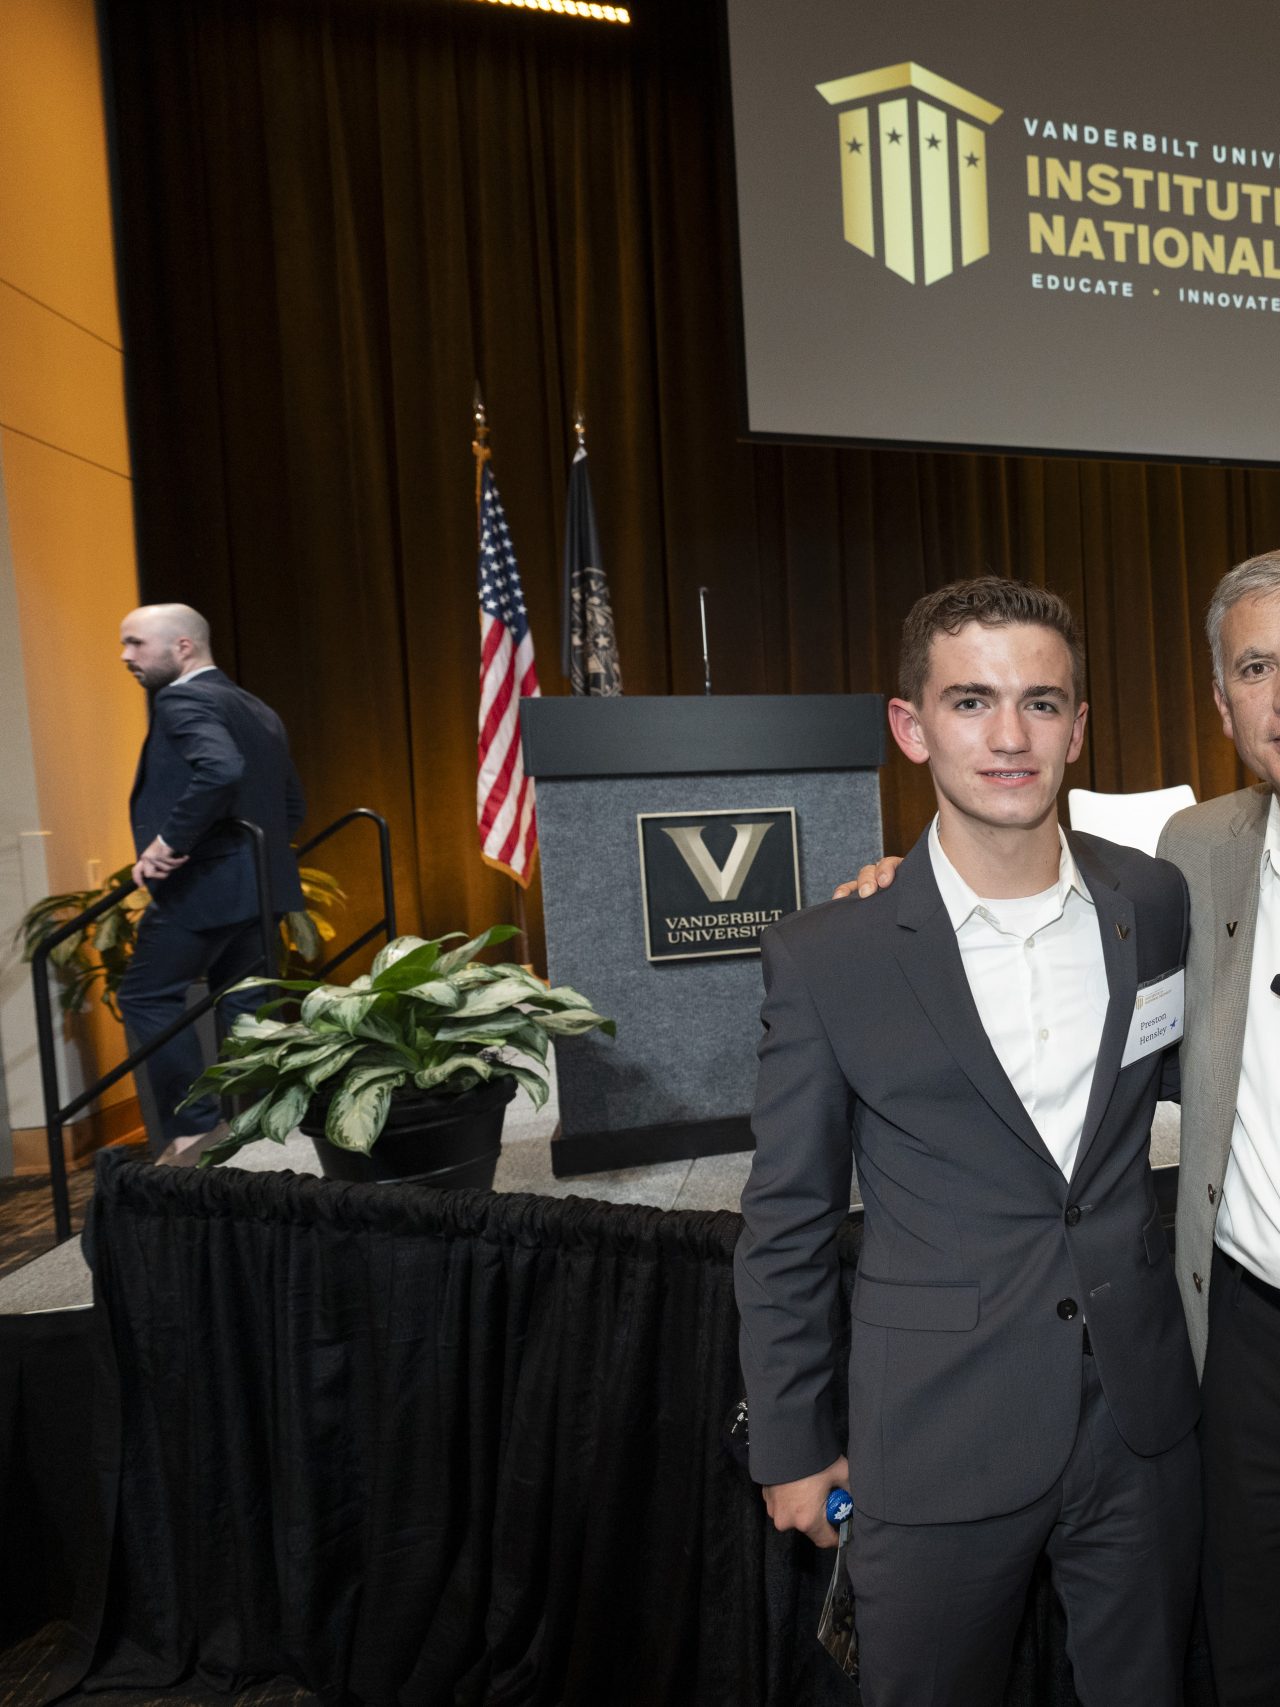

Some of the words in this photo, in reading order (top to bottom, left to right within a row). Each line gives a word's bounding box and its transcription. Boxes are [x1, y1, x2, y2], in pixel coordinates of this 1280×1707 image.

[1024, 117, 1198, 159] VANDERBILT
[1032, 273, 1134, 297] EDUCATE
[660, 823, 775, 902] V
[665, 910, 782, 929] VANDERBILT
[668, 924, 770, 944] UNIVERSIT
[1140, 1012, 1167, 1031] Preston
[1139, 1026, 1168, 1046] Hensley
